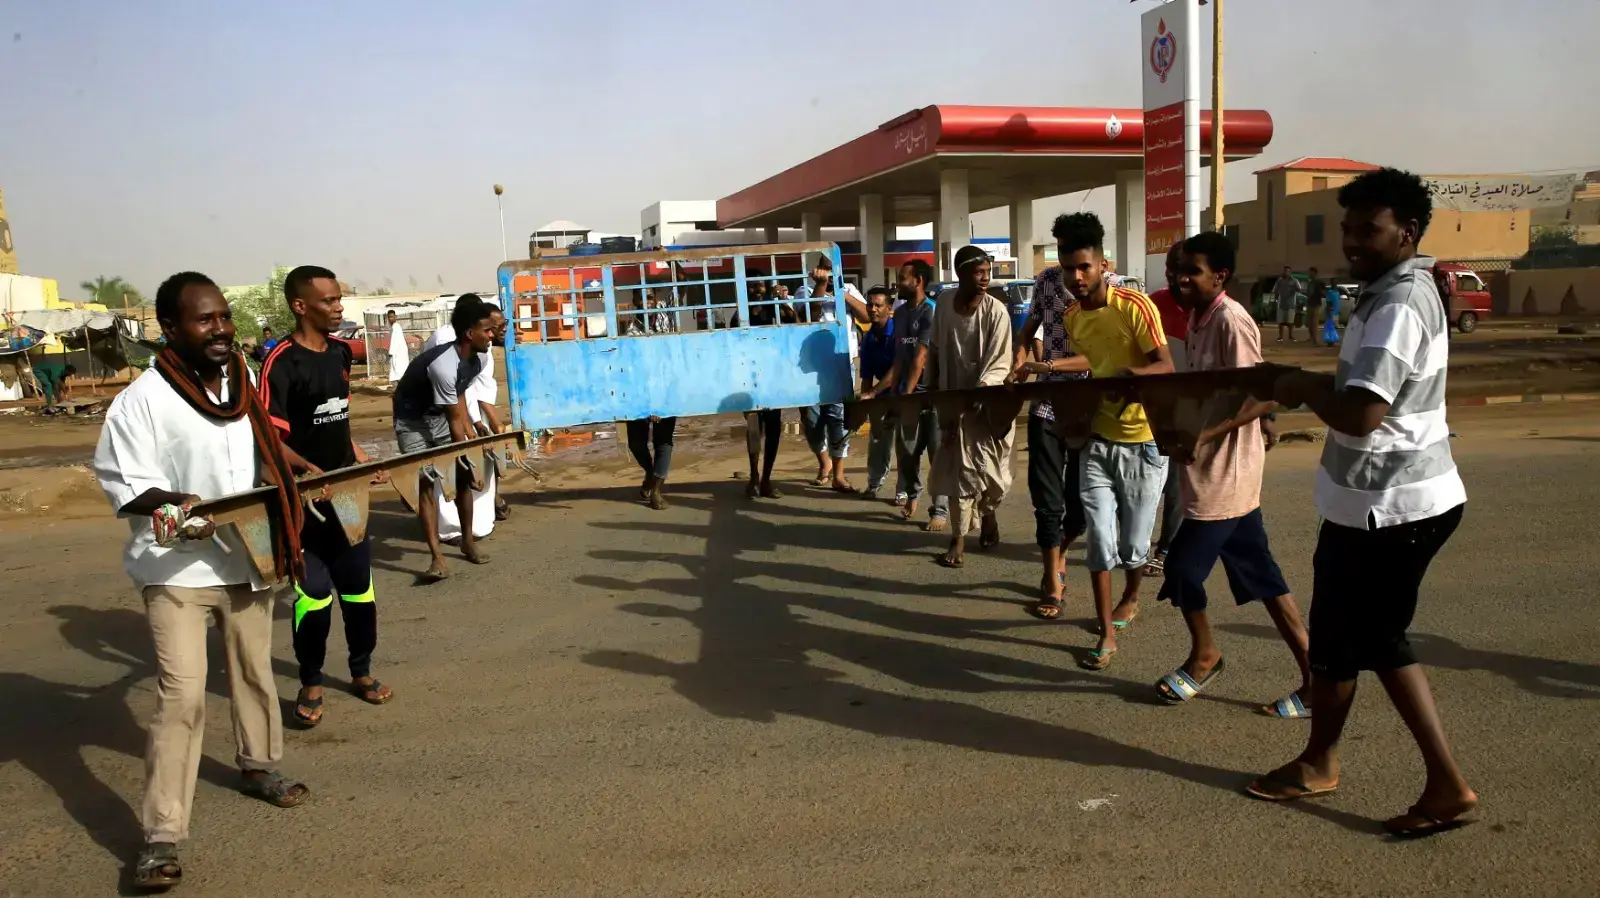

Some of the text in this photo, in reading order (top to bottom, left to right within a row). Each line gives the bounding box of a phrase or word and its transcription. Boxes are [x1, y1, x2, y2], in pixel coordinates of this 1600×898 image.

[1469, 182, 1481, 203] في
[1482, 184, 1508, 200] العيد
[1511, 183, 1544, 198] صلاة
[313, 411, 349, 424] CHEVROLE
